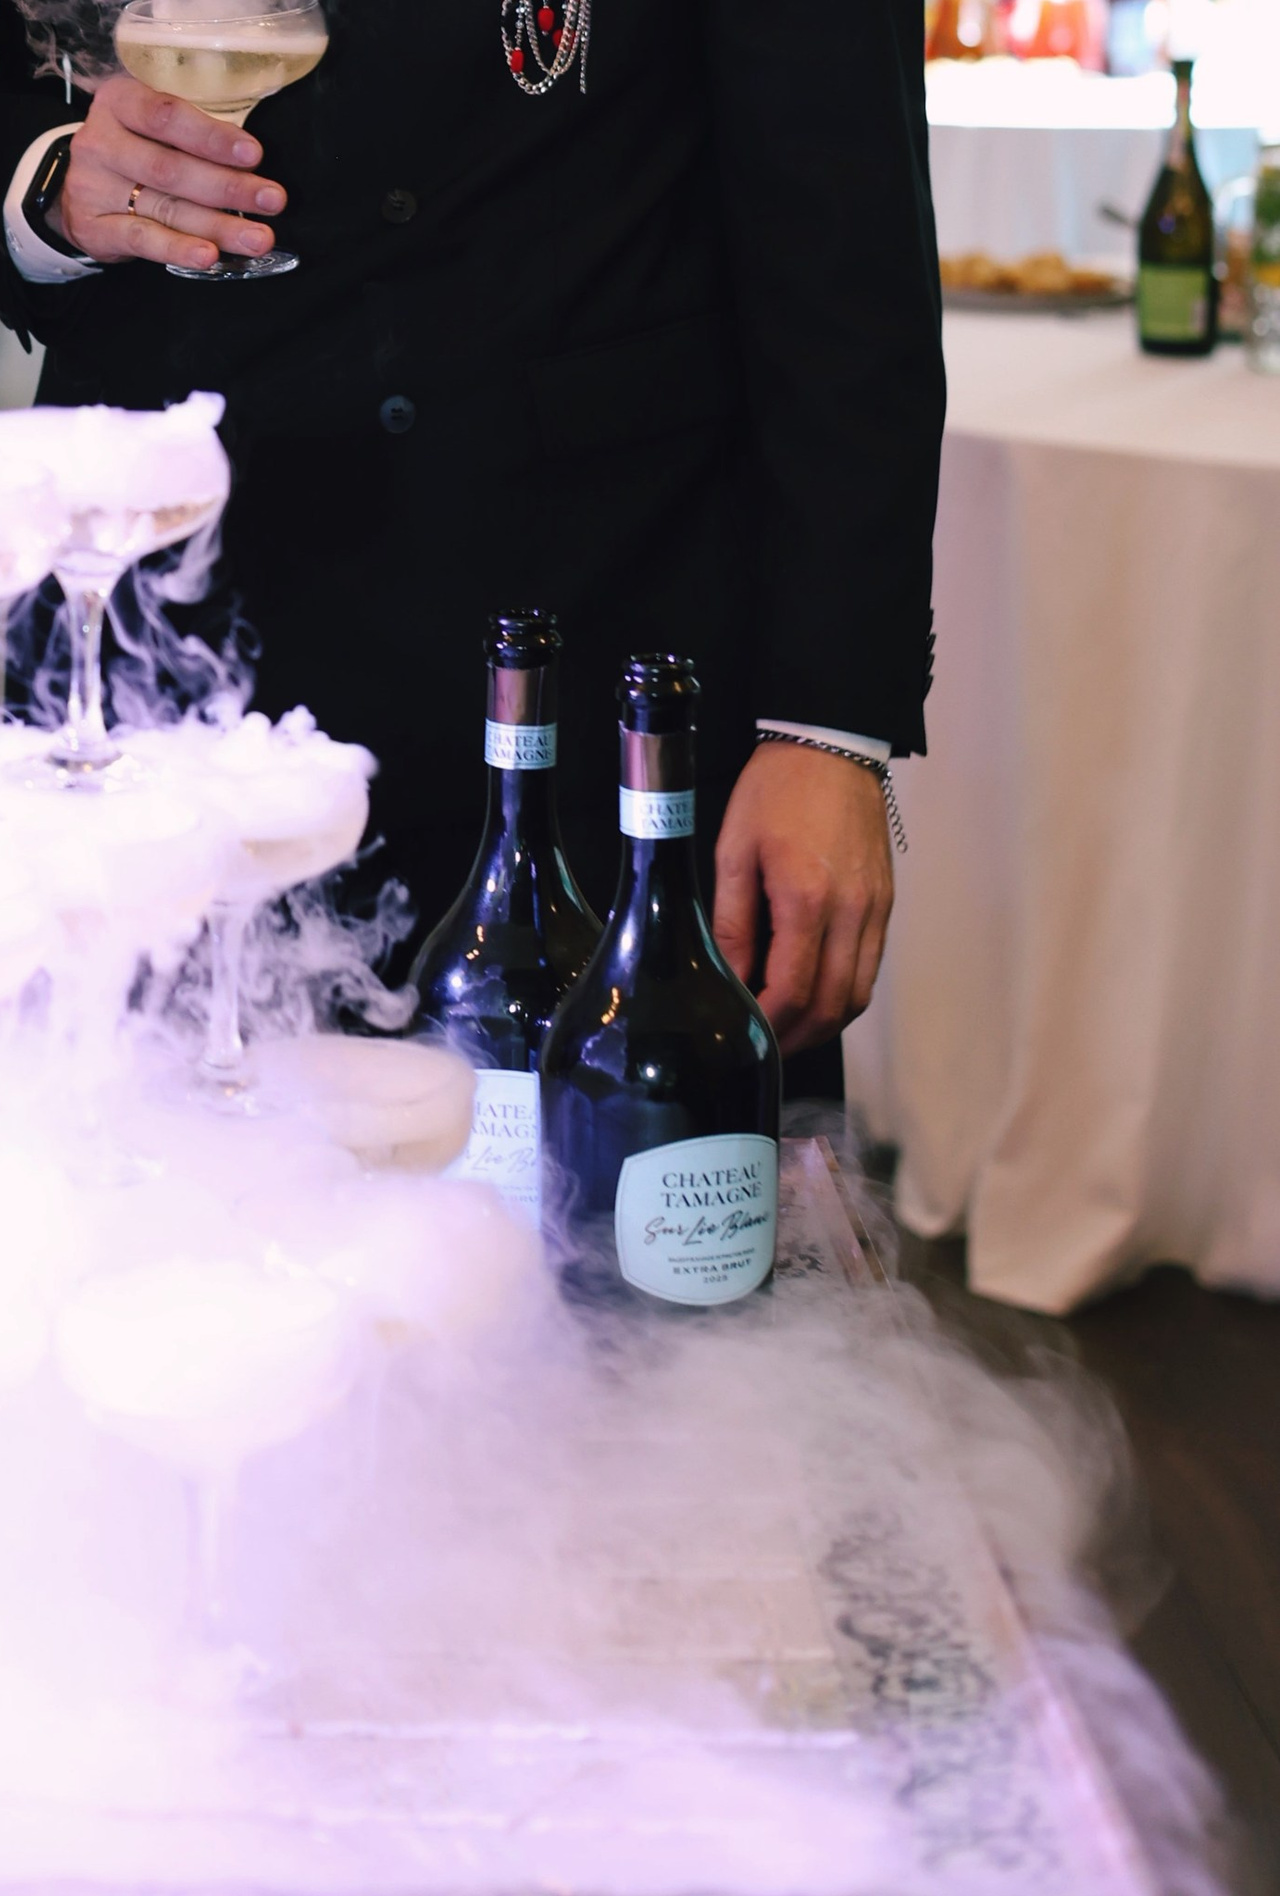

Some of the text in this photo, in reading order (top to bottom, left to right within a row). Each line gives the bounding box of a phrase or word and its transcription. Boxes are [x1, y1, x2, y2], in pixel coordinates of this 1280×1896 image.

[662, 1160, 761, 1189] CHATEAU
[659, 1181, 763, 1208] TAMAGNE
[672, 1257, 752, 1275] EXTRA BRUT
